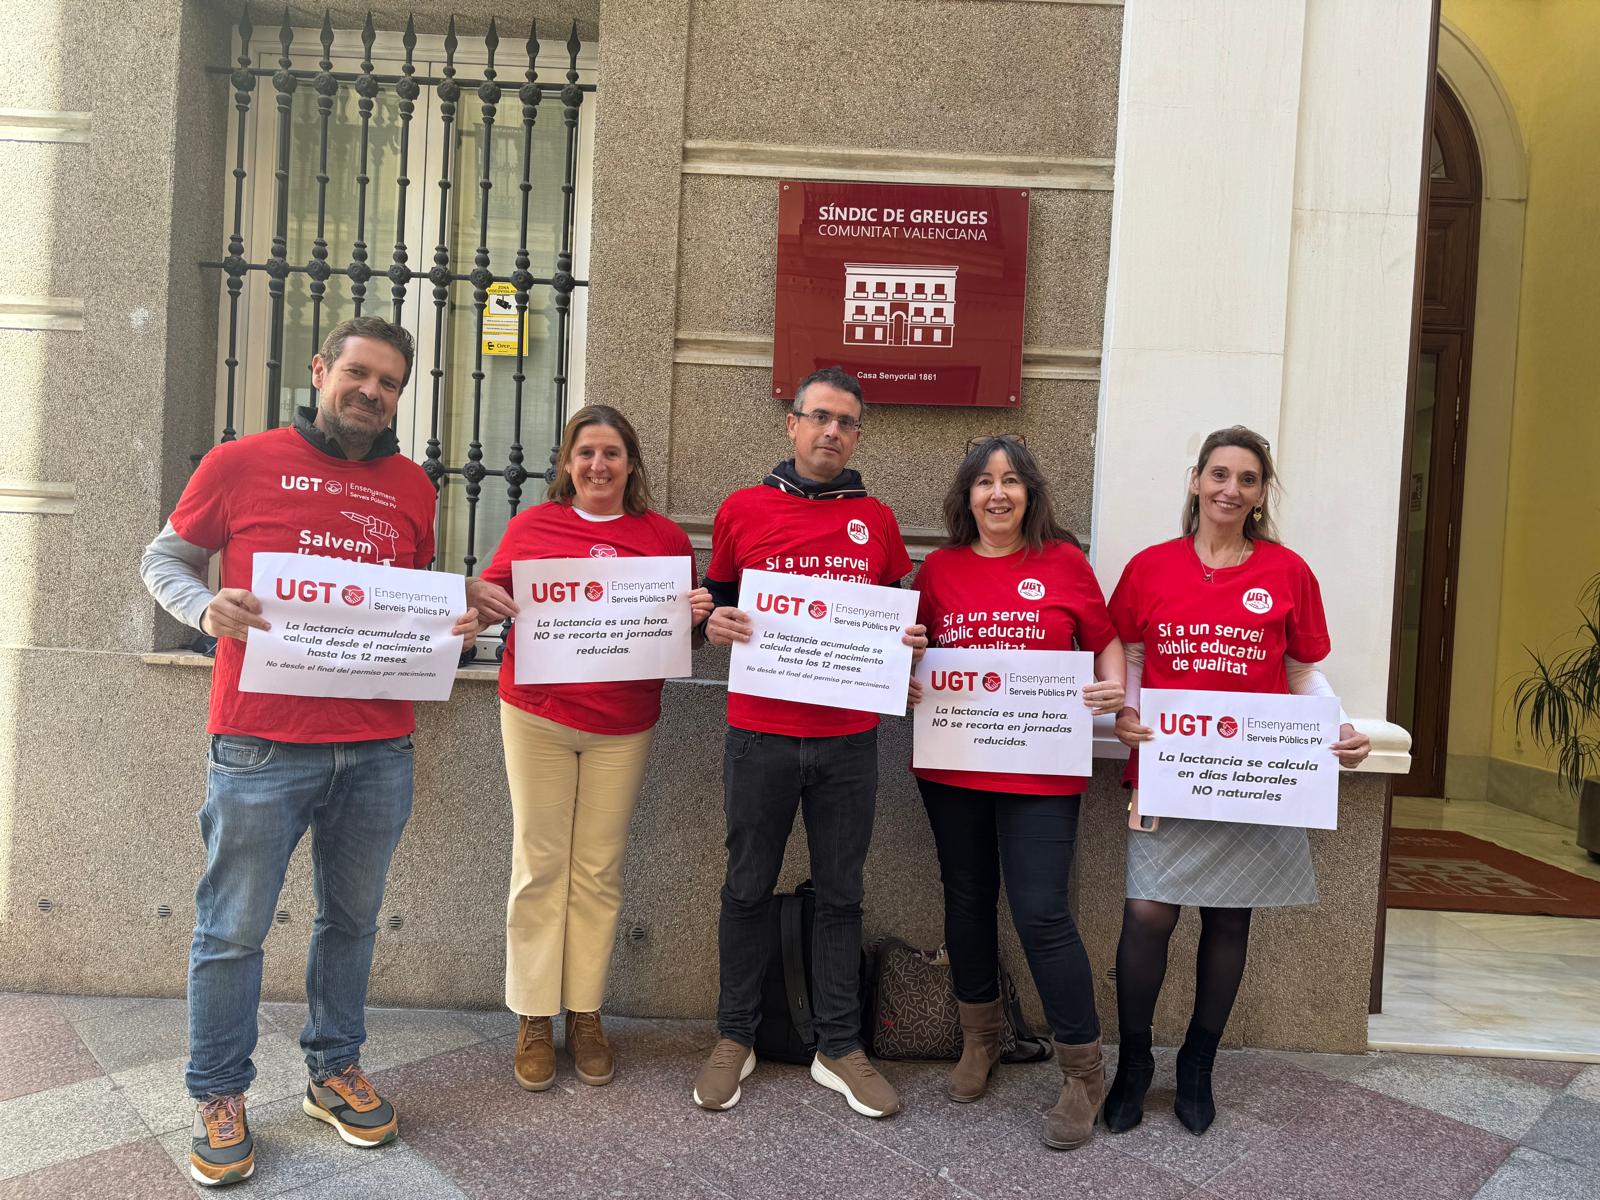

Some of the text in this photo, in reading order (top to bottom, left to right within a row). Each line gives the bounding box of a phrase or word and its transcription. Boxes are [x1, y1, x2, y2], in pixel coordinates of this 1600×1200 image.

[819, 202, 988, 225] SÍNDIC DE GREUGES
[818, 224, 987, 241] COMUNITAT VALENCIANA
[857, 371, 877, 380] Casa
[879, 372, 916, 382] Senyorial
[282, 475, 322, 492] UGT
[350, 483, 396, 501] Ensenyament
[350, 492, 370, 500] Serveis
[370, 497, 388, 506] Públics
[850, 522, 867, 534] UGT
[299, 529, 372, 554] Salvem
[766, 556, 868, 571] Sí a un servei
[276, 578, 336, 604] UGT
[532, 582, 581, 603] UGT
[611, 581, 675, 592] Ensenyament
[1021, 582, 1042, 593] UGT
[374, 587, 448, 605] Ensenyament
[756, 592, 805, 616] UGT
[1246, 592, 1269, 604] UGT
[374, 602, 450, 616] Serveis Públics PV
[836, 604, 900, 621] Ensenyament
[537, 619, 550, 627] La
[553, 619, 601, 627] lactancia
[834, 617, 861, 627] Serveis
[862, 620, 888, 631] Públics
[943, 610, 1040, 627] Sí a un servei
[286, 622, 430, 642] La lactancia acumulada se
[534, 632, 550, 640] NO
[624, 629, 672, 640] jornadas
[938, 624, 1046, 646] públic educatiu
[1158, 622, 1264, 643] Sí a un servei
[283, 633, 433, 654] calcula desde el nacimiento
[763, 631, 775, 639] La
[777, 633, 818, 645] lactancia
[821, 640, 870, 653] acumulada
[1158, 639, 1266, 661] públic educatiu
[307, 648, 338, 659] hasta
[341, 650, 356, 660] los
[361, 652, 371, 661] 12
[576, 646, 630, 655] reducidas.
[760, 642, 883, 665] calcula desde el nacimiento
[778, 655, 803, 666] hasta
[806, 658, 819, 667] los
[1172, 657, 1248, 676] de qualitat
[280, 662, 305, 671] desde
[317, 665, 335, 673] final
[351, 669, 381, 678] permiso
[383, 670, 396, 678] por
[814, 675, 840, 684] permiso
[931, 671, 978, 691] UGT
[1009, 672, 1075, 685] Ensenyament
[1038, 688, 1065, 697] Públics
[935, 706, 948, 714] La
[951, 706, 999, 716] lactancia
[1042, 710, 1068, 720] hora.
[932, 718, 947, 727] NO
[966, 722, 1004, 730] recorta
[1022, 723, 1072, 734] jornadas
[1160, 712, 1213, 737] UGT
[1247, 718, 1320, 732] Ensenyament
[974, 737, 1028, 747] reducidas.
[1247, 733, 1277, 743] Serveis
[1279, 735, 1309, 745] Públics
[1158, 752, 1175, 762] La
[1179, 752, 1243, 766] lactancia
[1268, 760, 1318, 771] calcula
[1178, 770, 1298, 786] en días laborales
[1192, 786, 1282, 802] NO naturales
